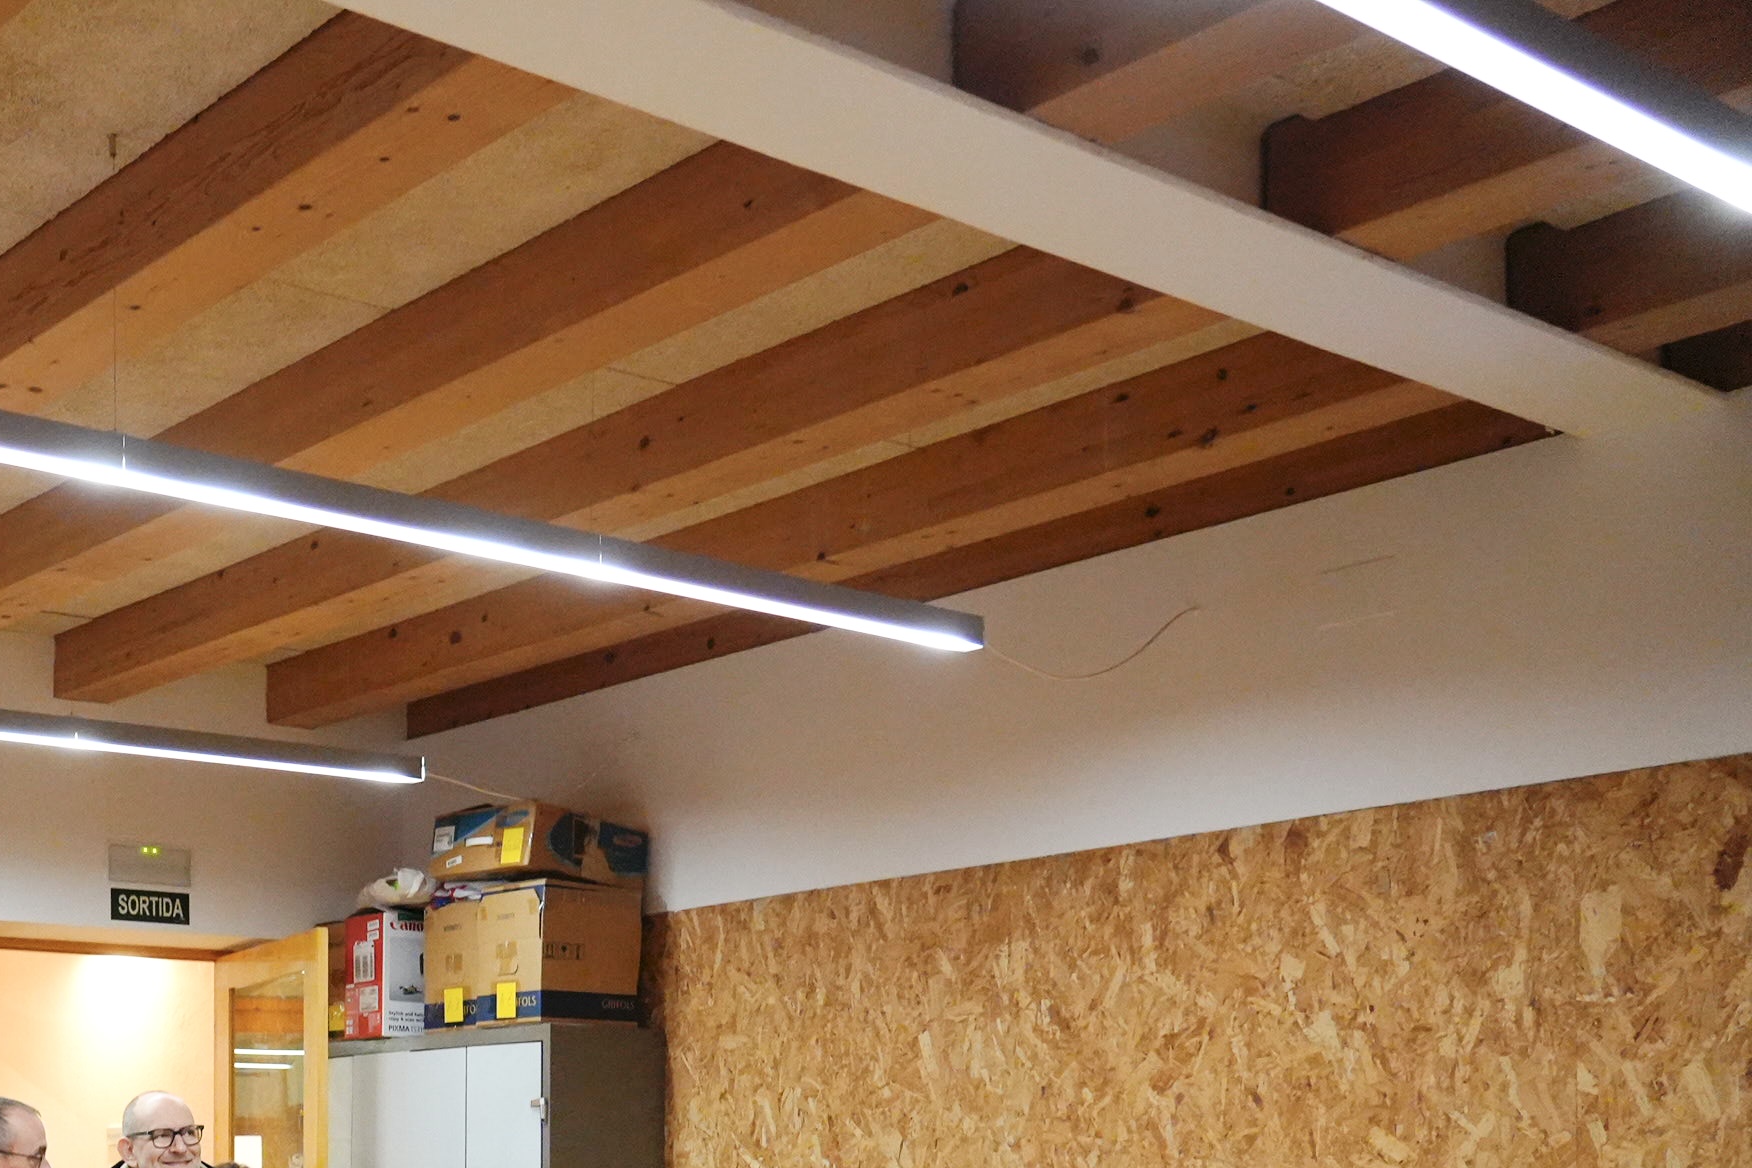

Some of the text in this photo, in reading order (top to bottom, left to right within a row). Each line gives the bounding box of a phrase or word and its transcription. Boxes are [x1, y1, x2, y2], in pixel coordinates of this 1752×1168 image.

[117, 893, 185, 920] SORTIDA
[389, 920, 425, 932] Cano
[388, 1024, 410, 1032] PIXMA
